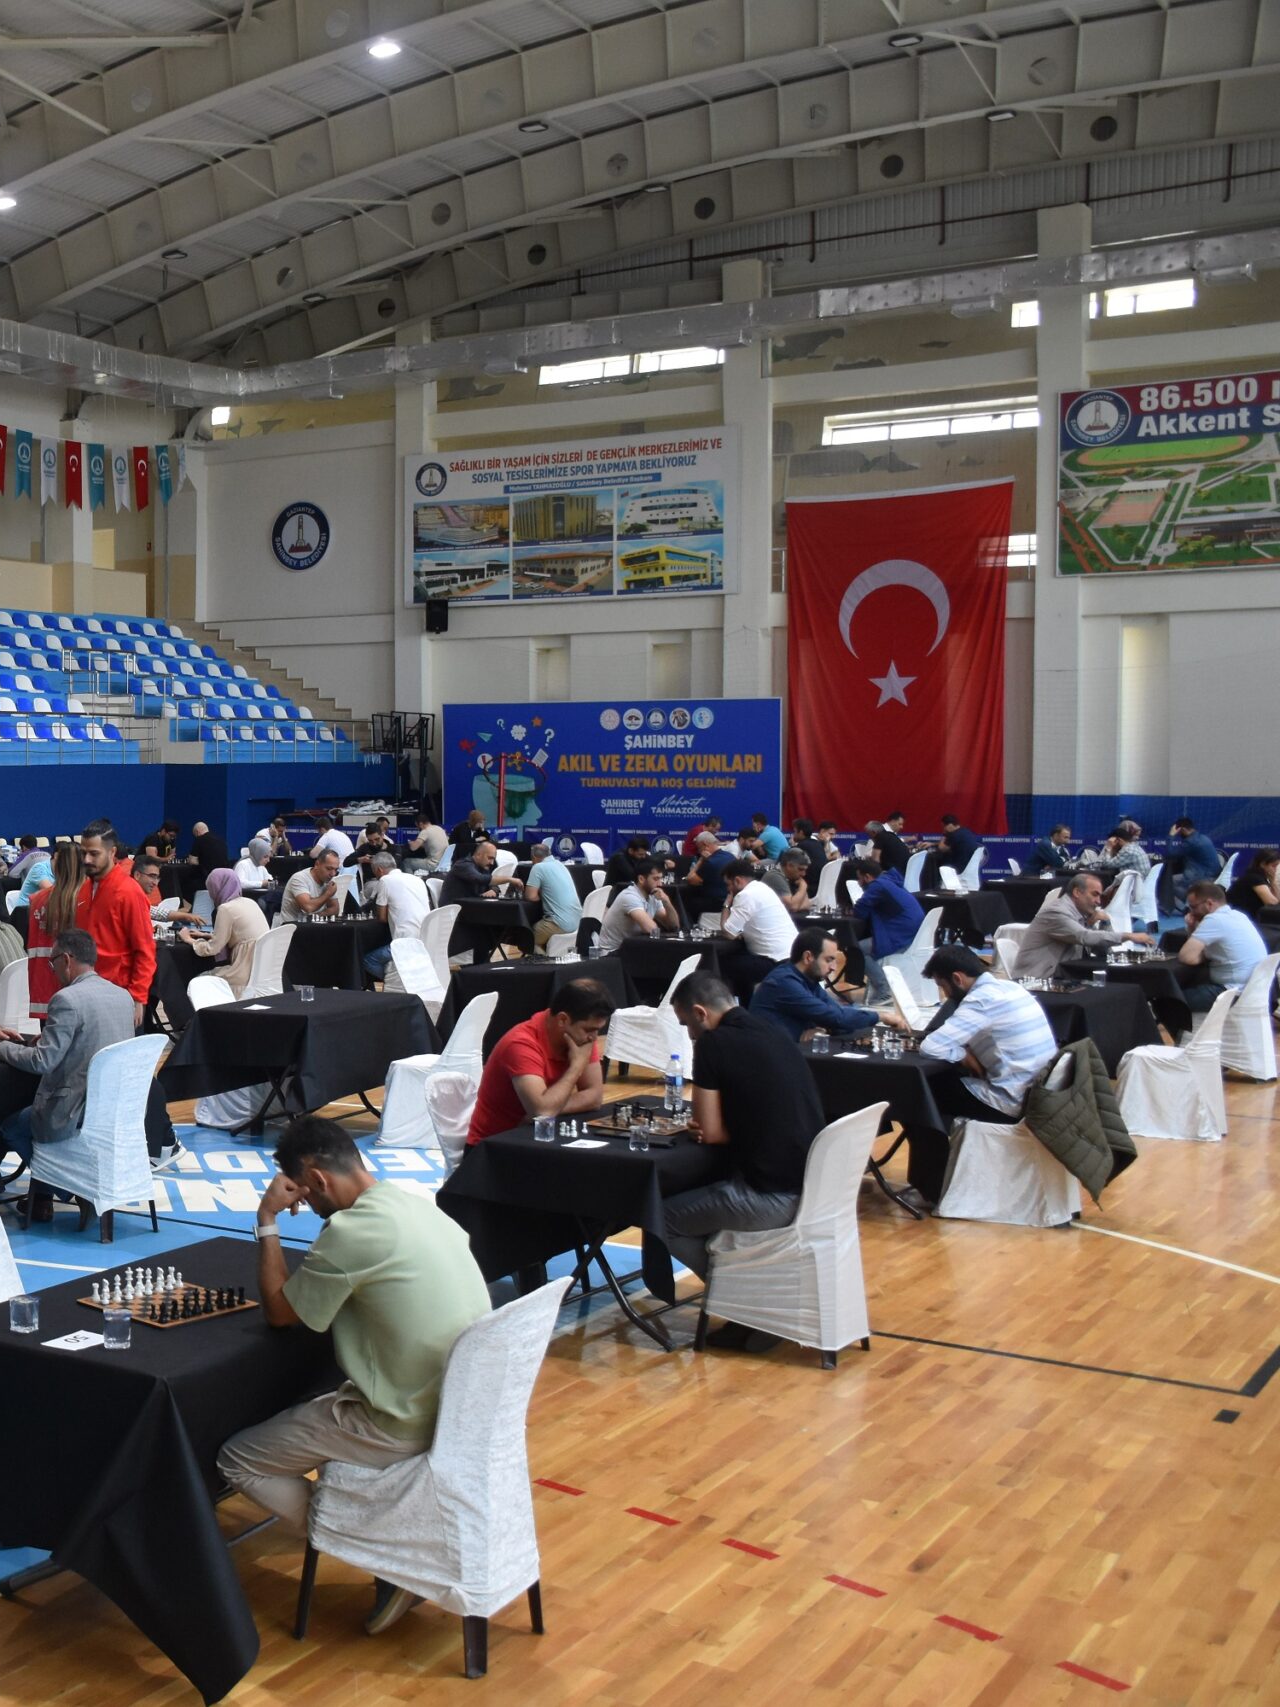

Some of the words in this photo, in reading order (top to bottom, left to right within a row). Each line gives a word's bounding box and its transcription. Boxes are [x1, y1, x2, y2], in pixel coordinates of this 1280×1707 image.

[1139, 377, 1258, 412] 86.500
[1137, 407, 1250, 438] Akkent
[449, 458, 486, 472] SAĞLIKLI
[487, 458, 501, 470] BİR
[503, 456, 531, 469] YAŞAM
[532, 453, 550, 466] İÇİN
[552, 451, 583, 465] SİZLERİ
[586, 450, 598, 461] DE
[600, 445, 637, 460] GENÇLİK
[638, 440, 708, 456] MERKEZLERİMİZ
[710, 438, 723, 449] VE
[472, 471, 504, 484] SOSYAL
[506, 467, 568, 481] TESİSLERİMİZE
[570, 464, 594, 477] SPOR
[596, 461, 638, 474] YAPMAYA
[640, 455, 697, 471] BEKLİYORUZ
[624, 734, 695, 750] ŞAHİNBEY
[558, 753, 595, 772] AKIL
[599, 753, 621, 772] VE
[624, 753, 669, 772] ZEKA
[673, 753, 762, 772] OYUNLARI
[580, 777, 658, 788] TURNUVASI'NA
[661, 777, 683, 789] HOŞ
[686, 776, 737, 788] GELDİNİZ
[651, 805, 711, 815] TAHMAZOĞLU
